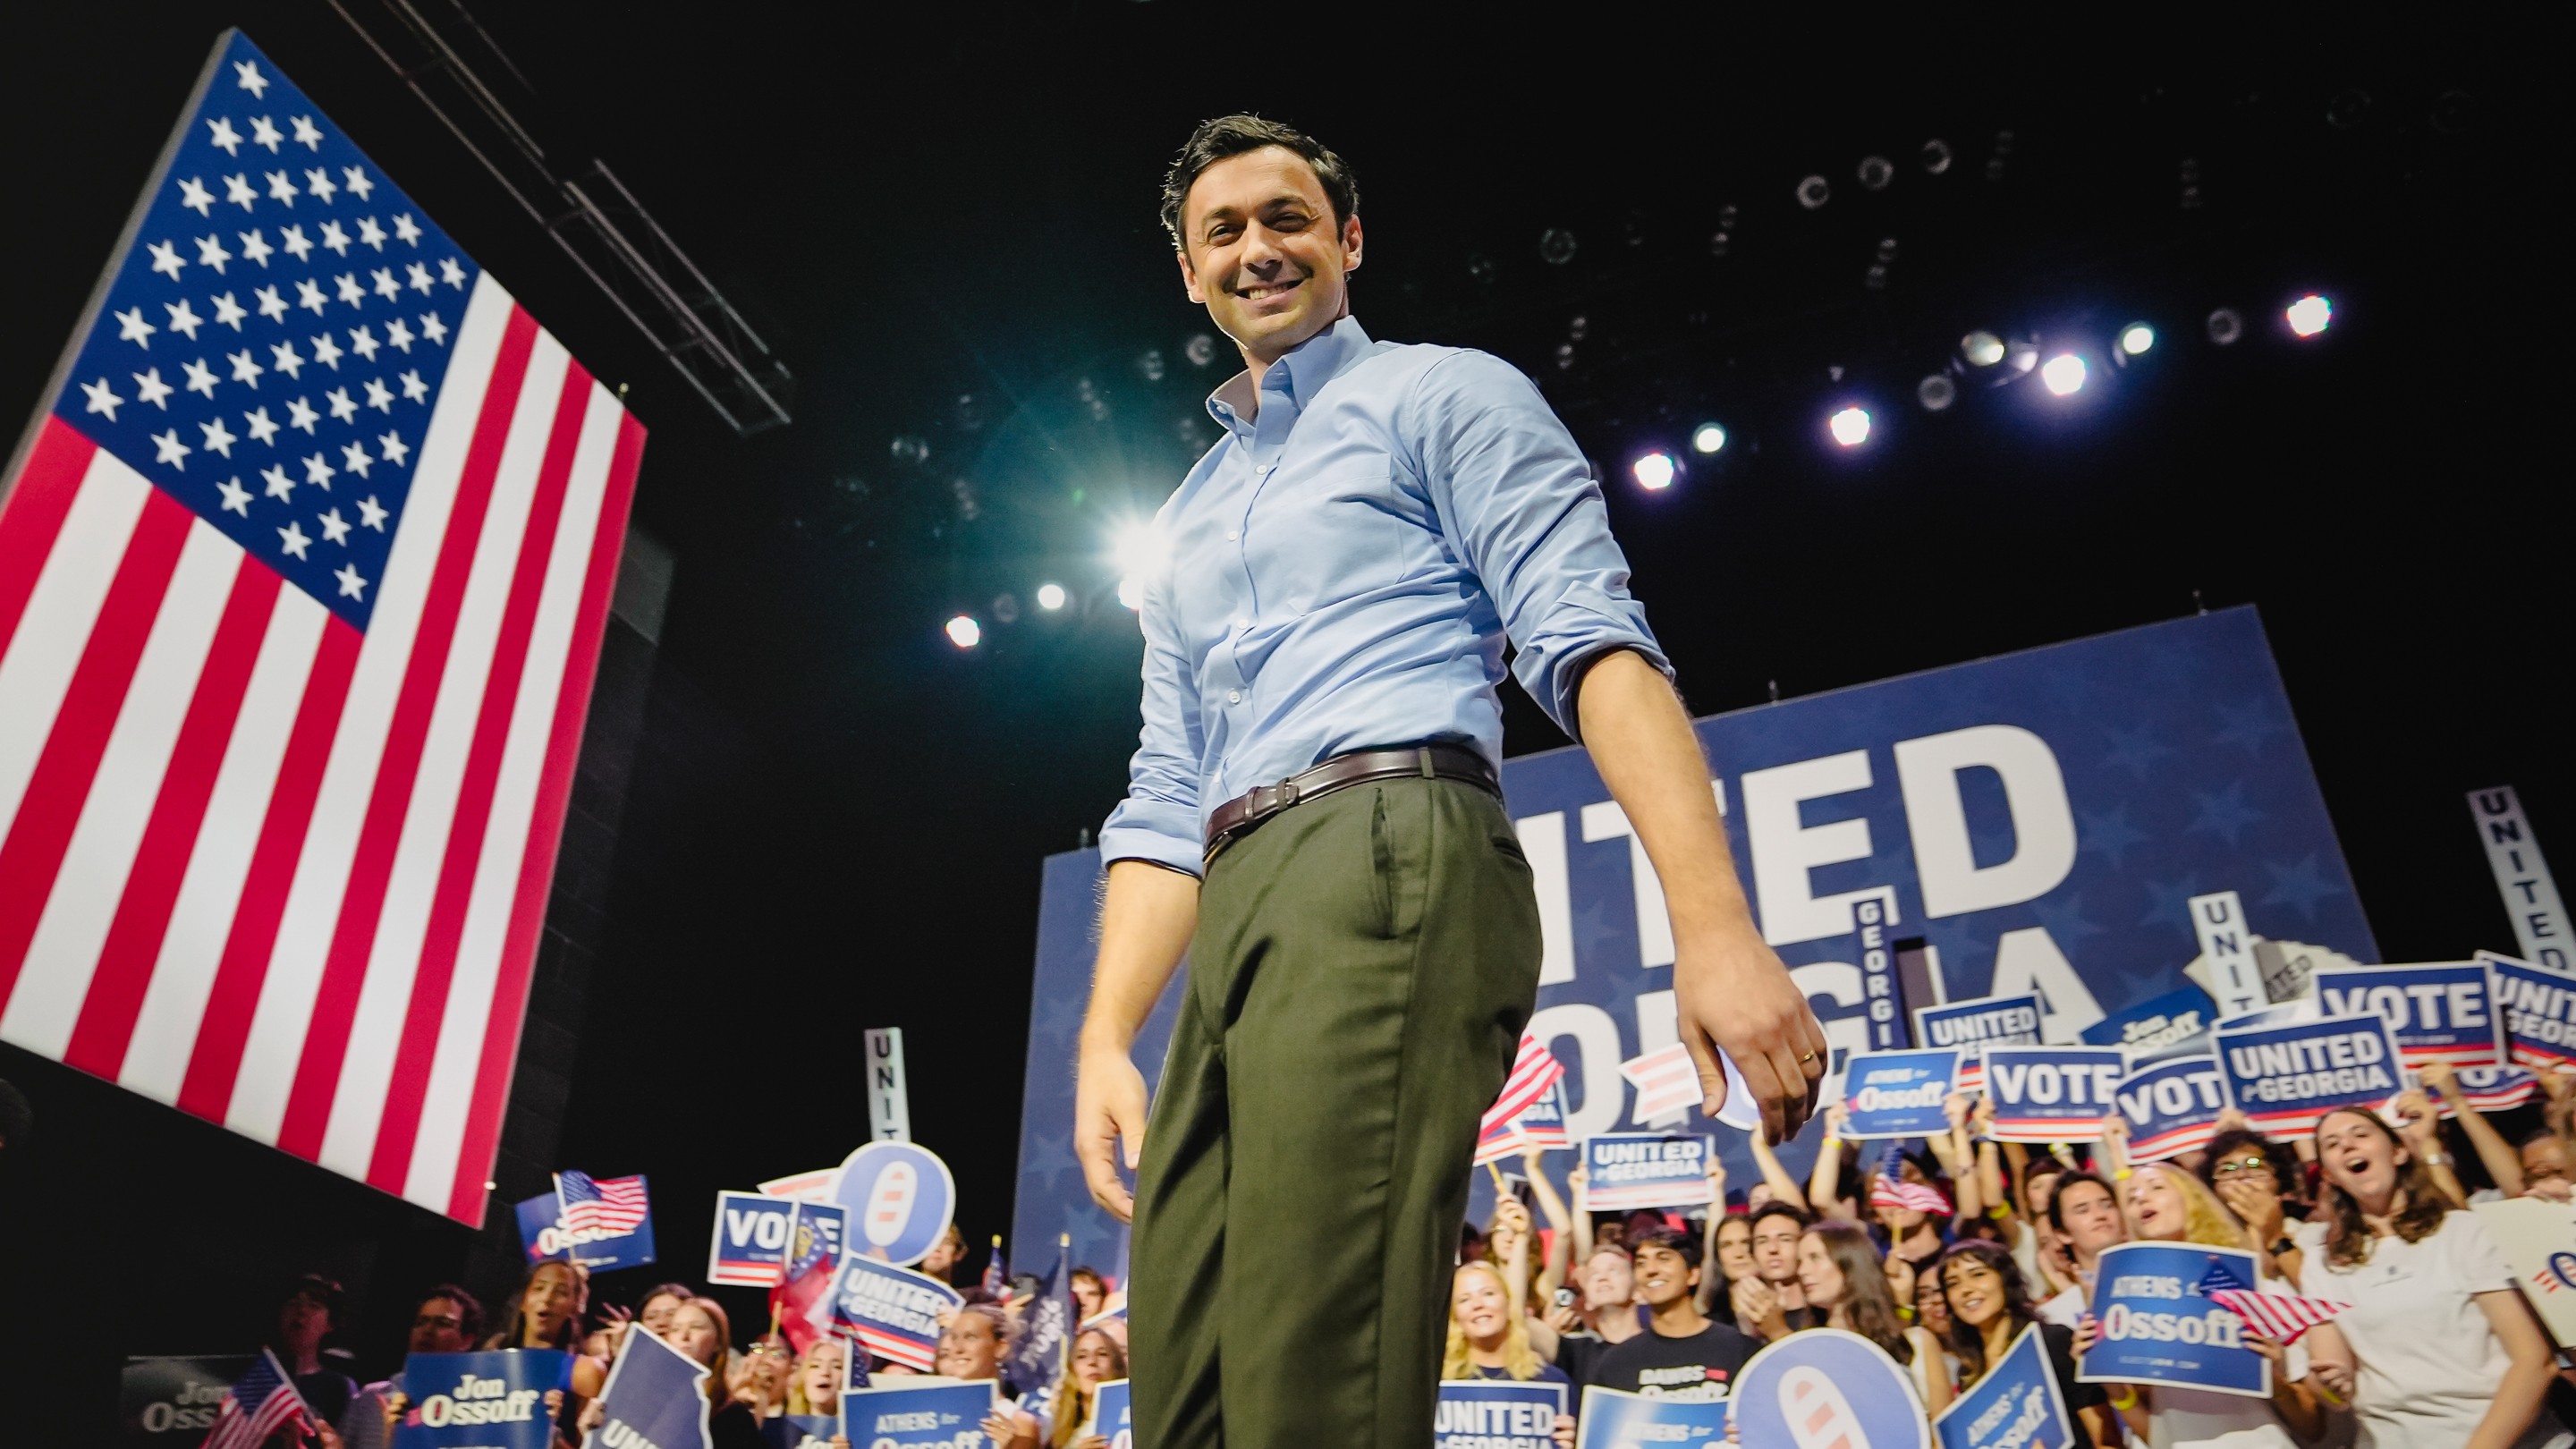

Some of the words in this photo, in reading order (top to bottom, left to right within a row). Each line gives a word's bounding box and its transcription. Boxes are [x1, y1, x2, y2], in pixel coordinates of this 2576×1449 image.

[2479, 792, 2567, 970] UNITED
[1858, 901, 1894, 1046] GEORGI
[2205, 901, 2255, 1012] UNIT
[1930, 1006, 2038, 1046] UNITED
[2323, 982, 2487, 1030] VOTE
[2230, 1031, 2385, 1080] UNITED
[1992, 1063, 2122, 1106] VOTE
[2118, 1071, 2224, 1126] VOT
[2258, 1064, 2394, 1103] GEORGIA
[1595, 1141, 1702, 1165] UNITED
[1607, 1158, 1701, 1182] GEORGIA
[2105, 1303, 2243, 1349] Ossoff
[420, 1389, 539, 1428] Ossoff
[453, 1375, 505, 1400] Jon
[1435, 1401, 1556, 1436] UNITED
